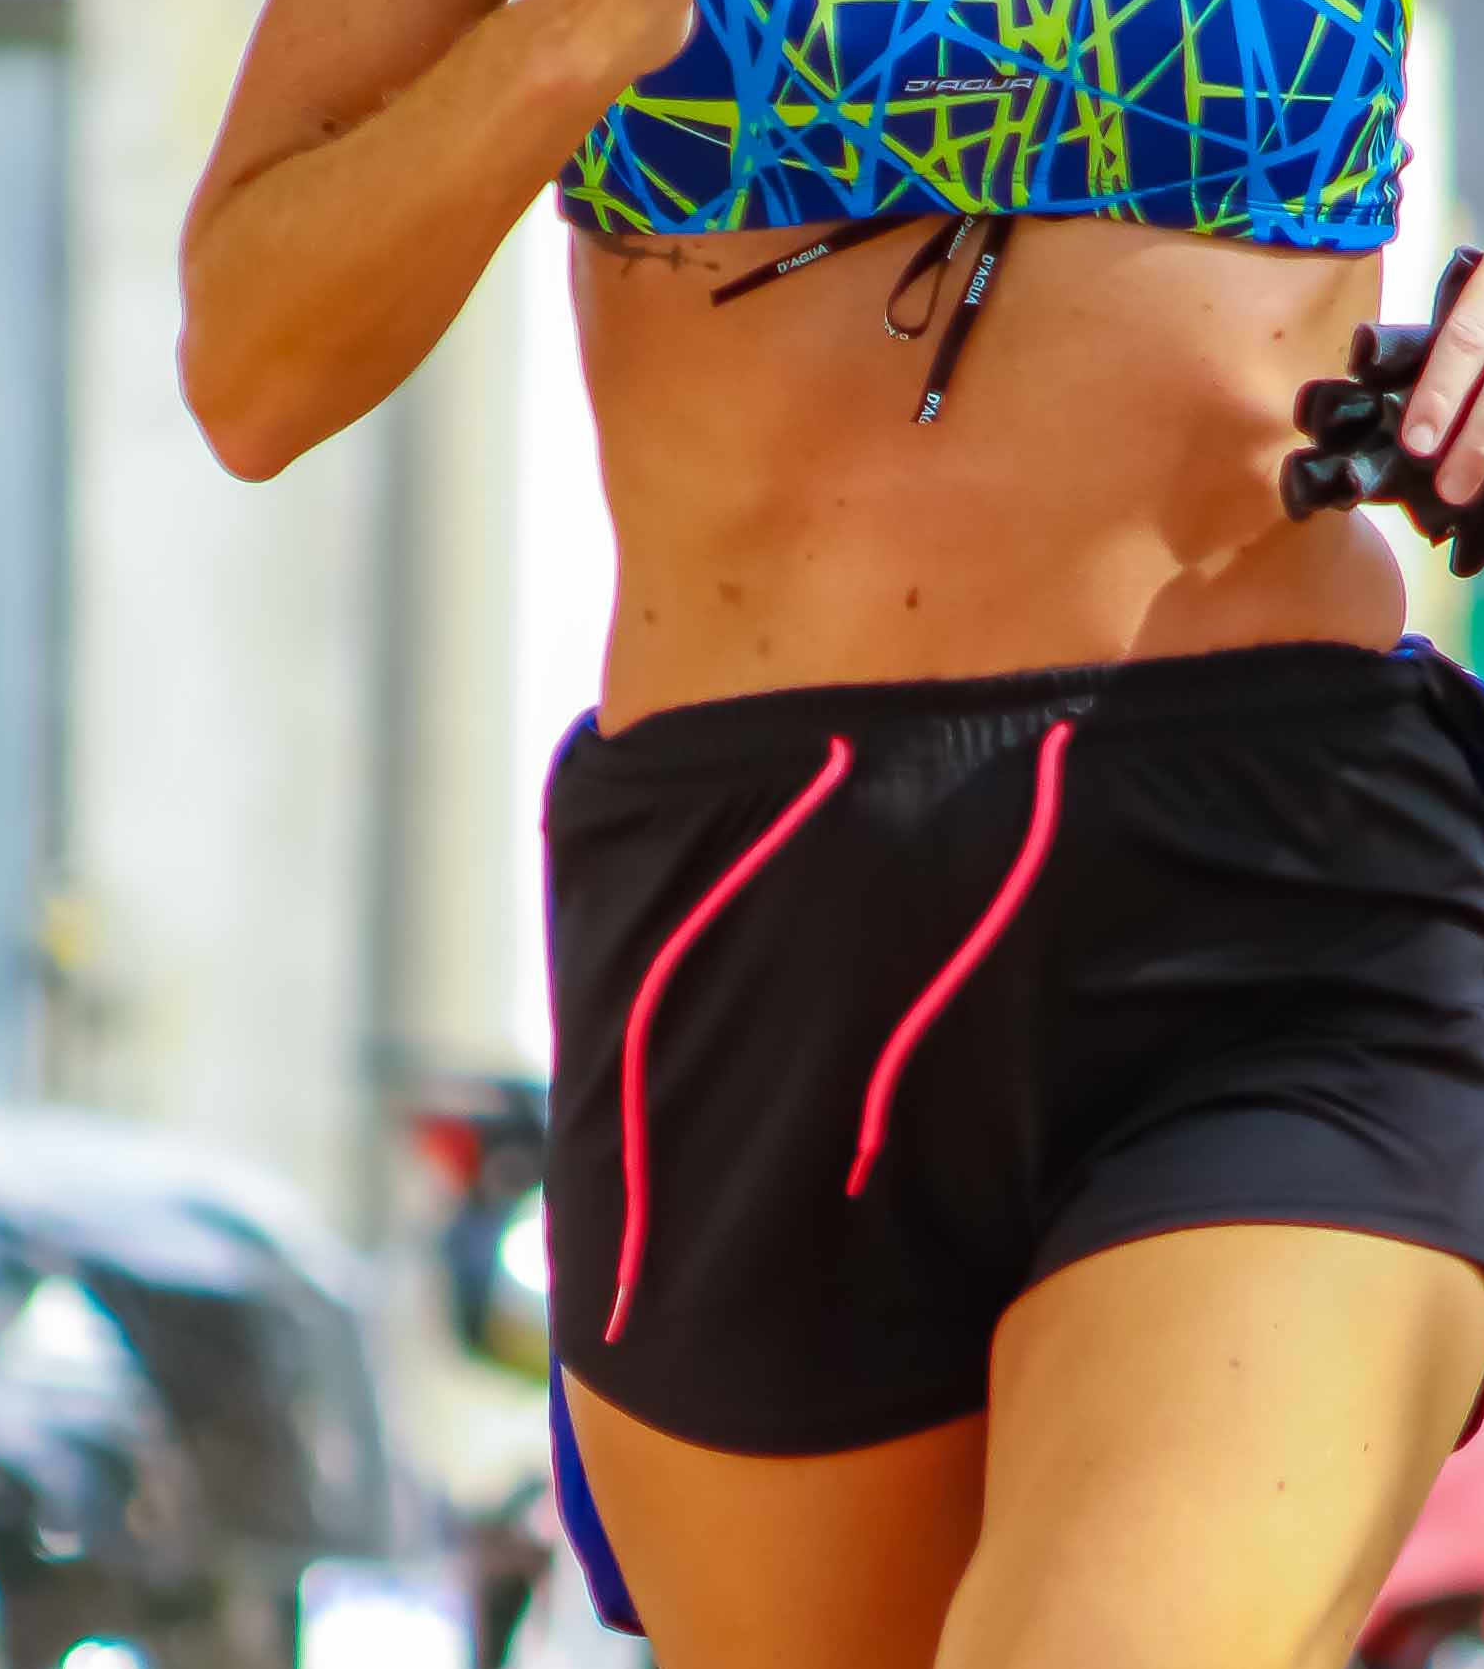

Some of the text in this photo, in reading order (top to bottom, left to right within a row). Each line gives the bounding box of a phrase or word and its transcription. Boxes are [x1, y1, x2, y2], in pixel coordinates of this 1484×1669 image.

[904, 78, 1034, 91] D'AGUA
[777, 243, 830, 274] D'AGUA
[965, 253, 995, 304] D'AGUA
